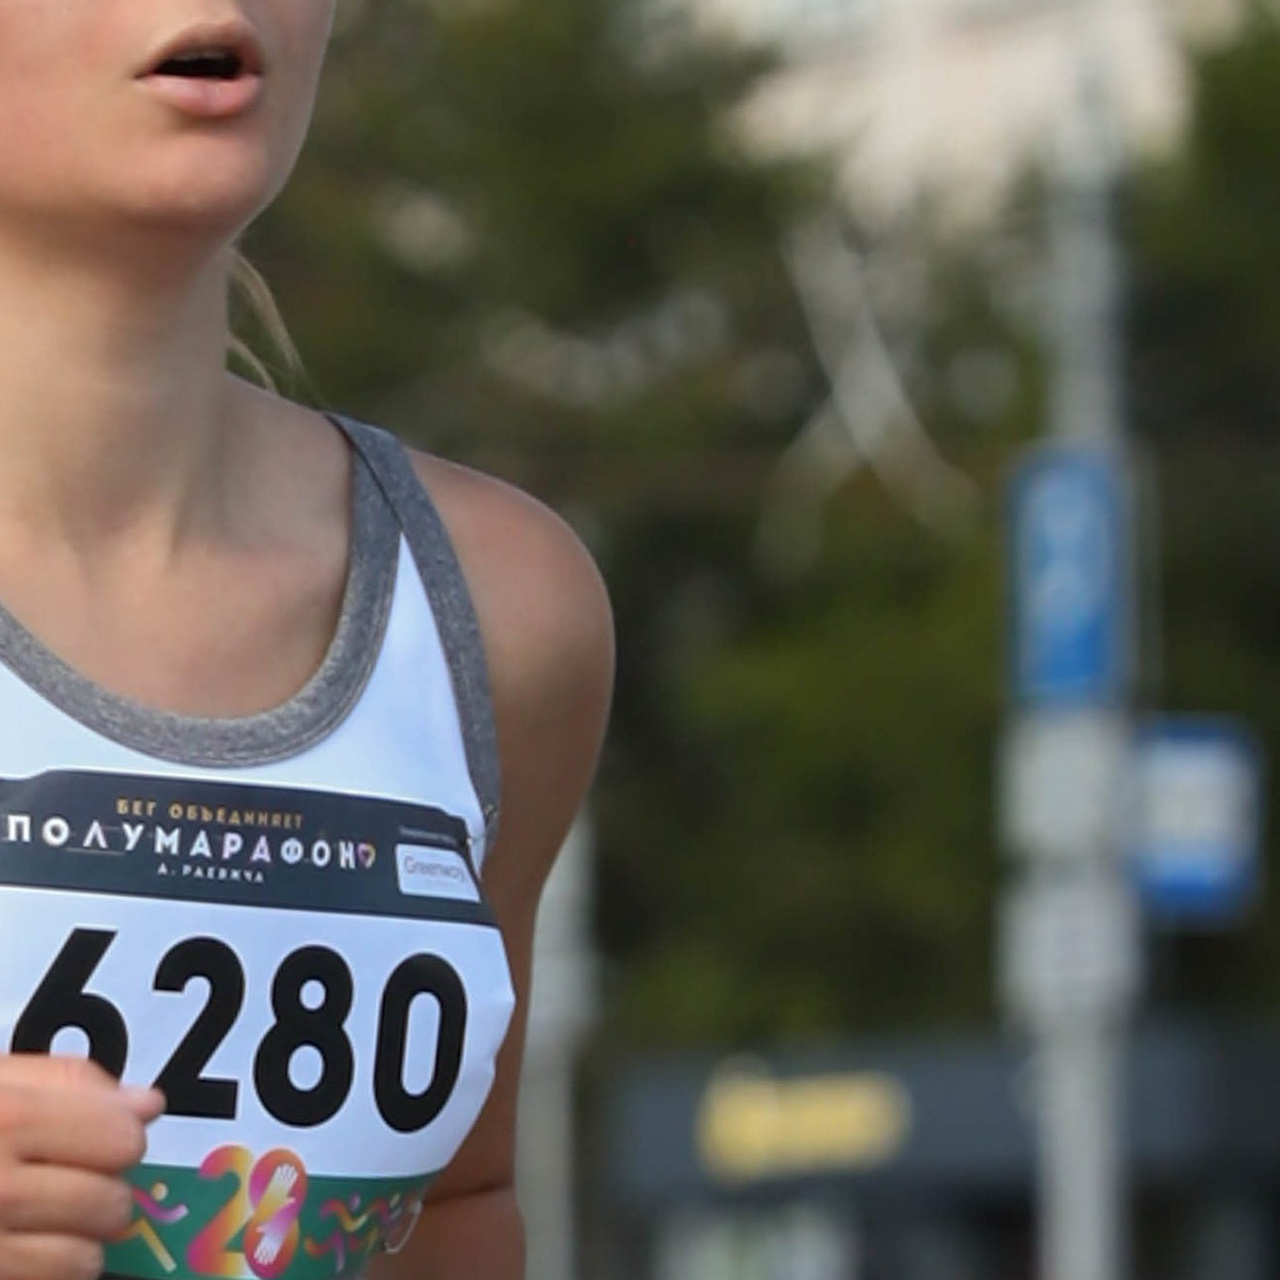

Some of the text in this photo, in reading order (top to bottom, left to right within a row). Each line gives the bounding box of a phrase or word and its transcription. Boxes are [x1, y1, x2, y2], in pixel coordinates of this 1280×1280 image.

[116, 797, 157, 818] БЕГ
[6, 814, 356, 870] ПОЛУМАРАФОН
[10, 927, 468, 1134] 6280
